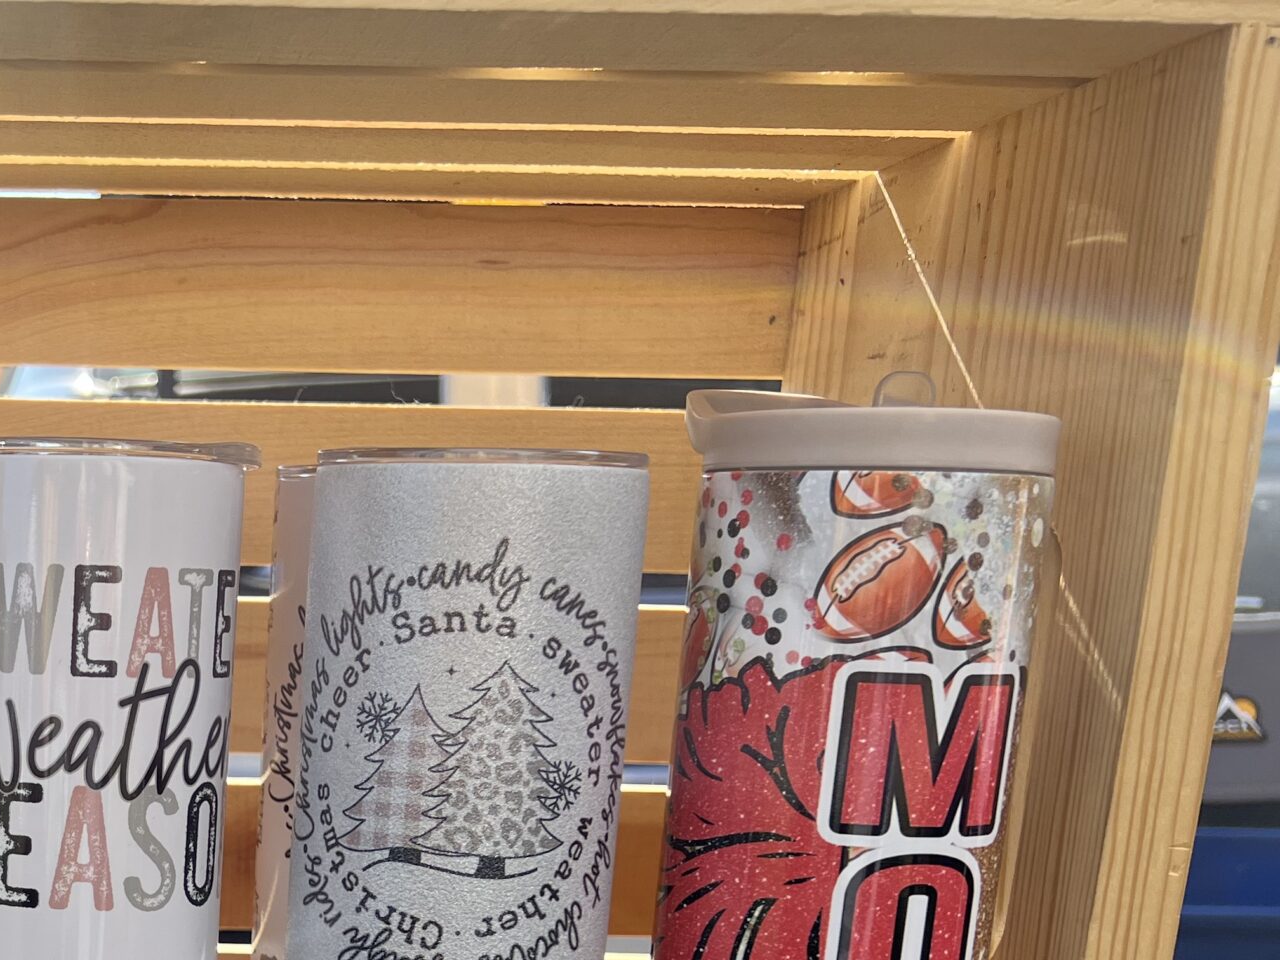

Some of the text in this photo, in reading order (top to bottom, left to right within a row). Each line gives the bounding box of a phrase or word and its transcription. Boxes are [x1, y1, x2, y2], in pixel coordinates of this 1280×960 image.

[321, 564, 404, 657] lights
[417, 537, 530, 612] candy
[539, 577, 607, 647] canes
[317, 603, 601, 952] Santa sweater weather Christmas cheer
[302, 854, 344, 928] rides
[583, 839, 613, 910] hot
